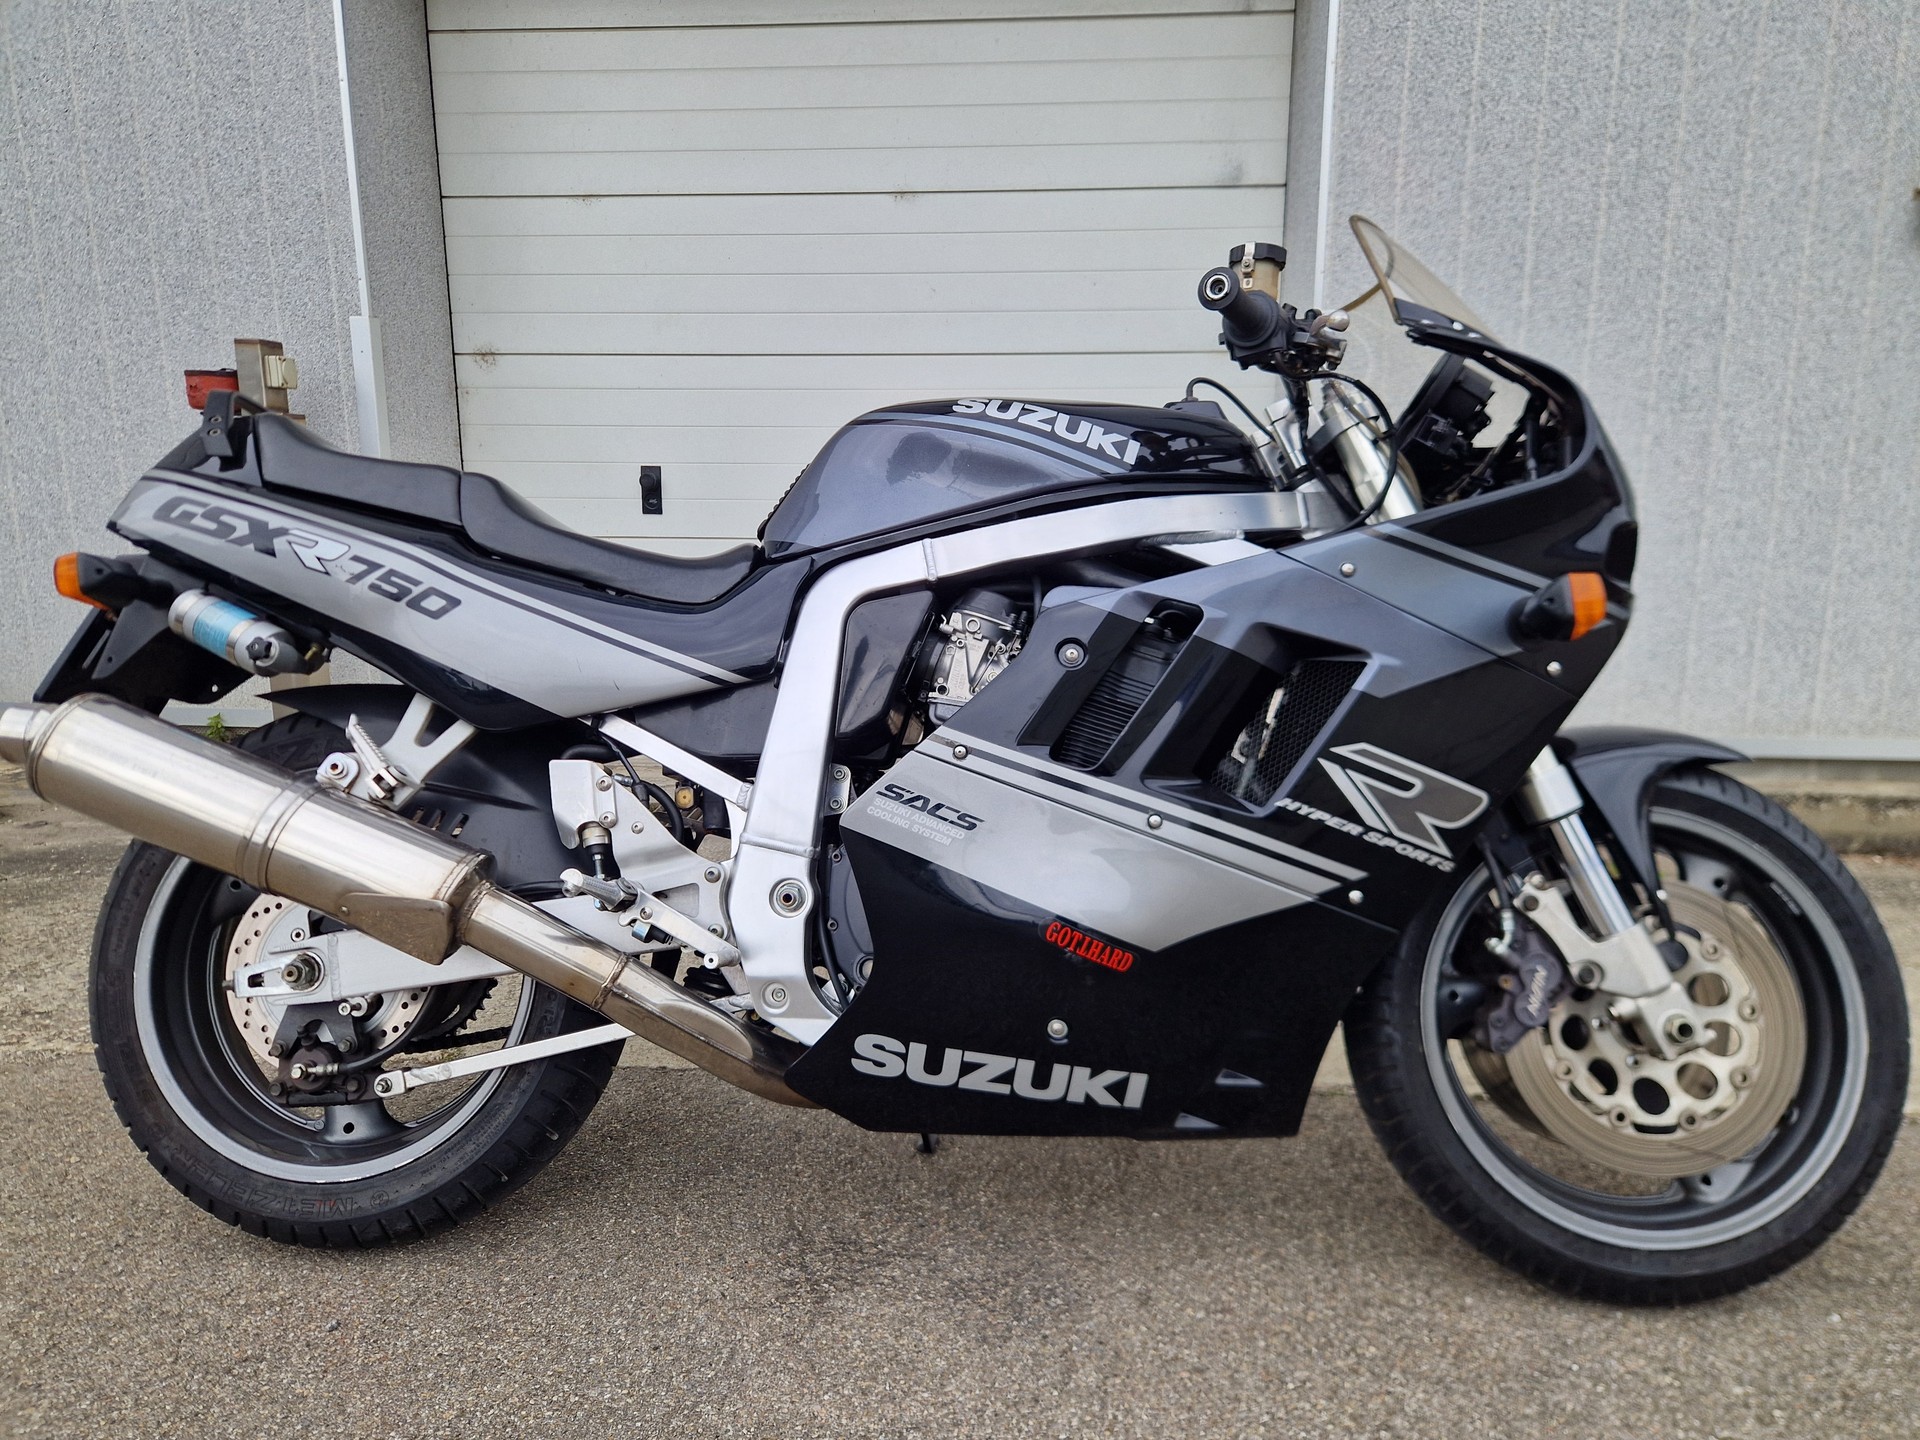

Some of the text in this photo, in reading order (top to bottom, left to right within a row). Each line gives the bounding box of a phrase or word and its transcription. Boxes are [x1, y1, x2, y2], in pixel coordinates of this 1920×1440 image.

[952, 398, 1141, 465] SUZUKI
[866, 806, 953, 846] COOLING SYSTEM
[873, 797, 966, 840] SUZUKI ADVANCED
[876, 783, 985, 831] SACS
[1317, 742, 1491, 859] R
[1274, 797, 1457, 873] HYPER SPORTS
[851, 1033, 1149, 1109] SUZUKI
